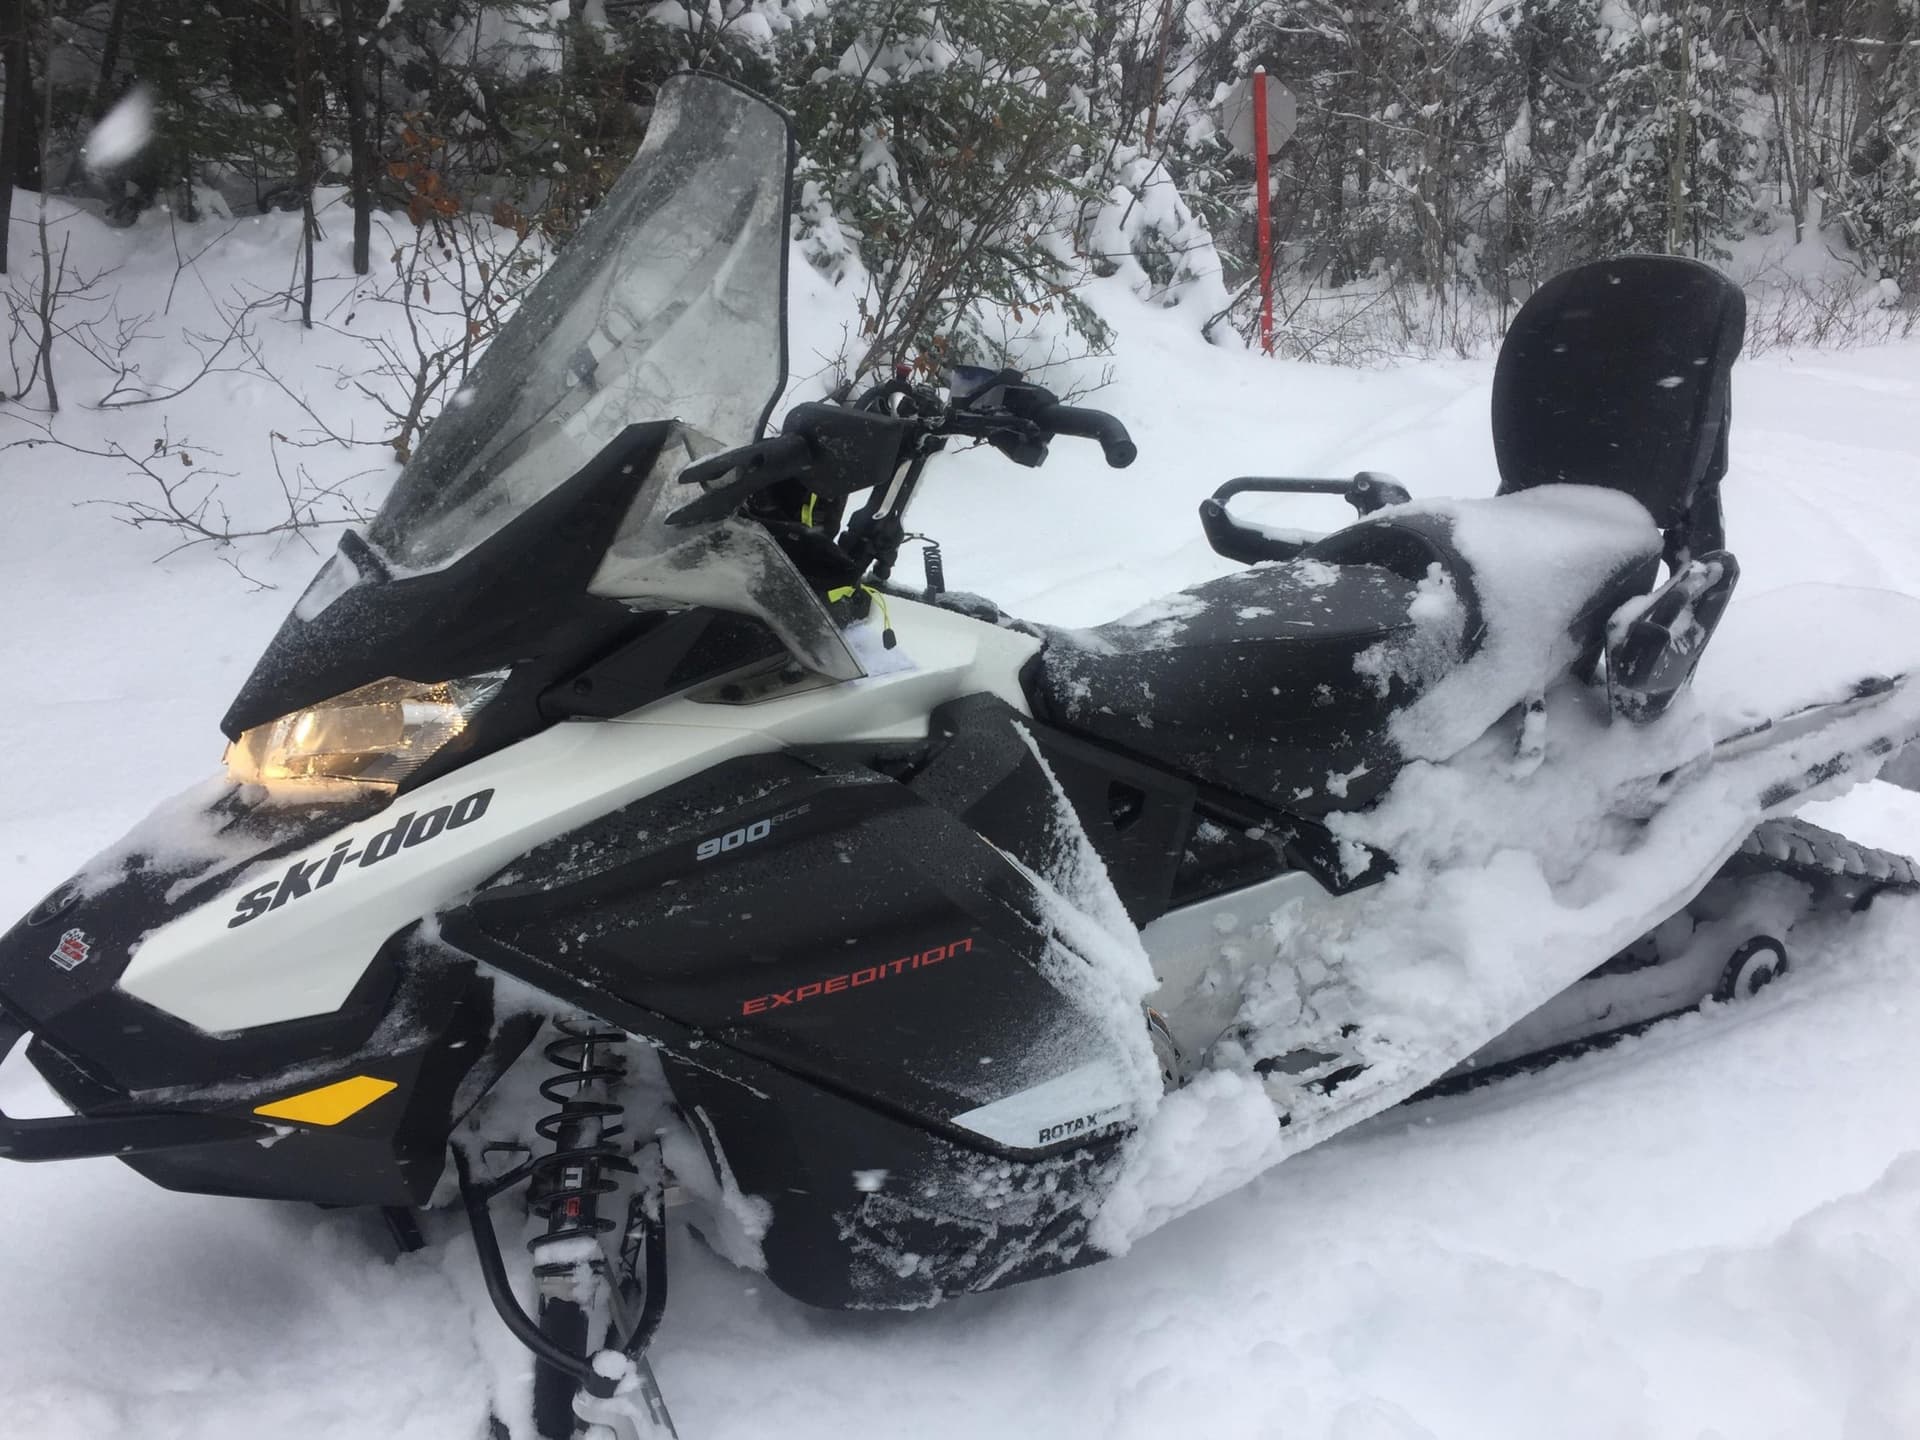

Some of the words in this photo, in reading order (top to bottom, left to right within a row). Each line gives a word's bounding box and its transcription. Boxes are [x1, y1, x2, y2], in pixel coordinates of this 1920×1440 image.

[227, 788, 495, 929] ski-doo
[696, 819, 771, 861] 900
[742, 938, 974, 1016] EXPEDITION
[1039, 1112, 1098, 1144] ROTAX
